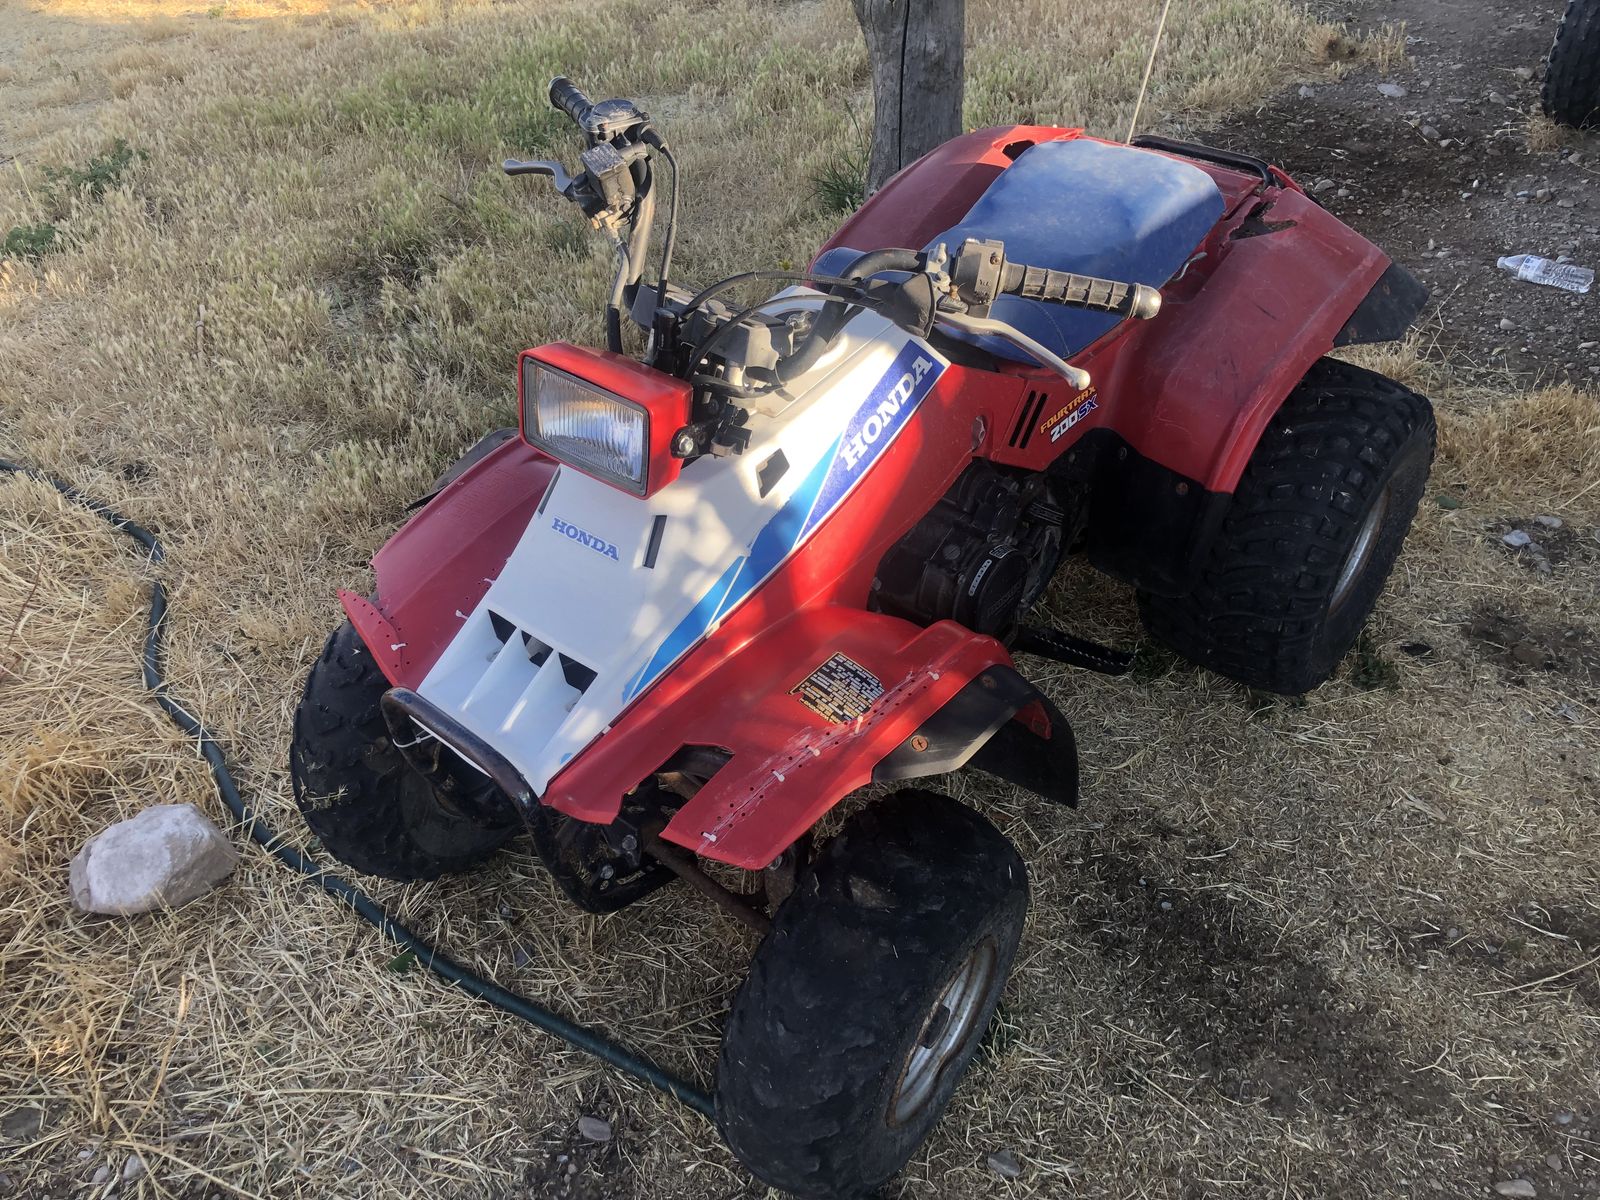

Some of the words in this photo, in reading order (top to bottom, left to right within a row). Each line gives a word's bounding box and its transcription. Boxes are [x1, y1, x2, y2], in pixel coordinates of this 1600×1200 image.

[840, 356, 933, 471] HONDA
[1040, 386, 1096, 434] FOURTRAX
[1051, 393, 1099, 443] 200SX
[551, 517, 619, 561] HONDA
